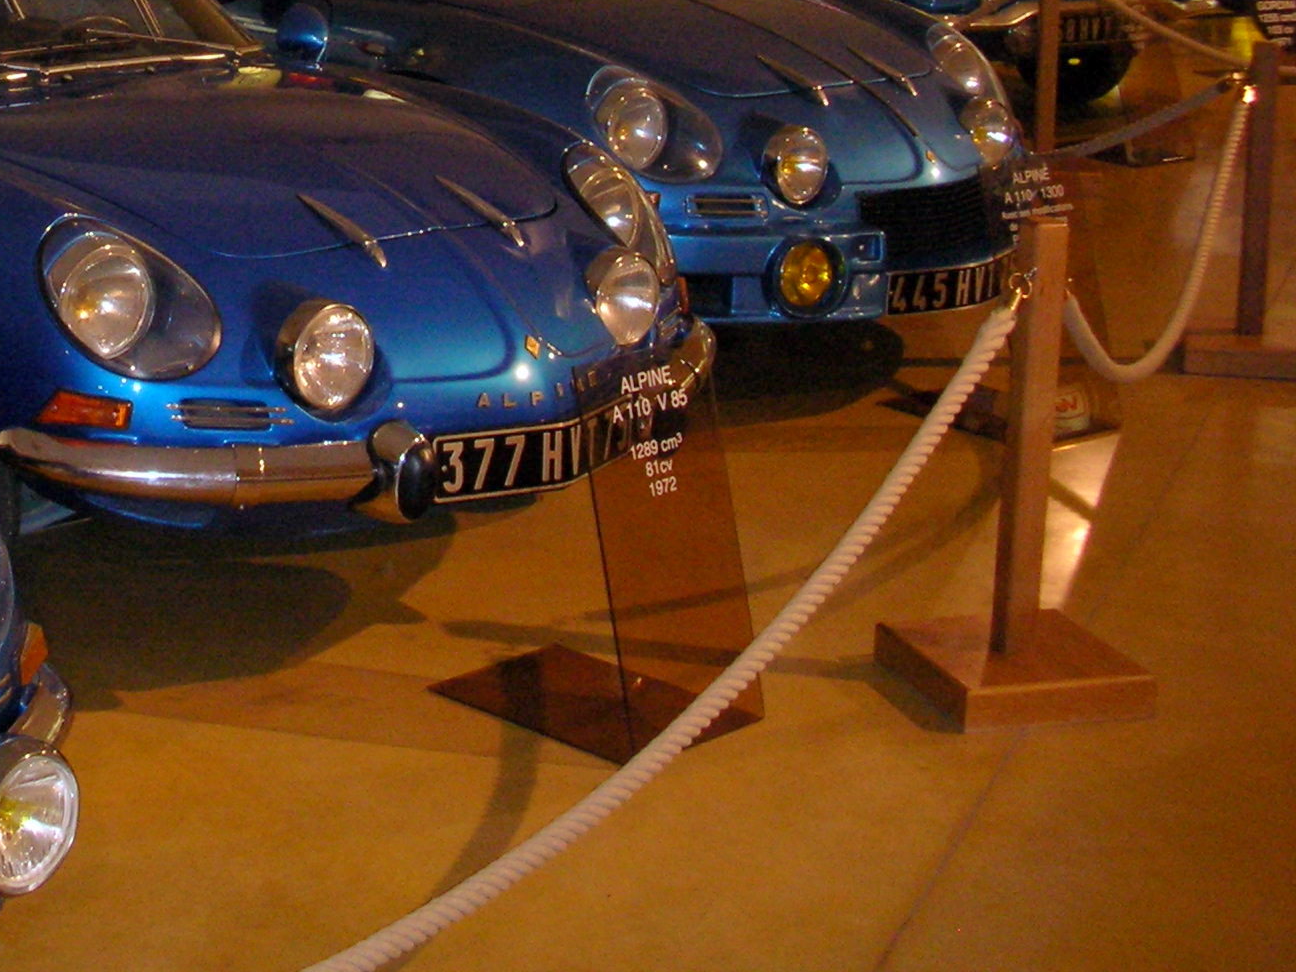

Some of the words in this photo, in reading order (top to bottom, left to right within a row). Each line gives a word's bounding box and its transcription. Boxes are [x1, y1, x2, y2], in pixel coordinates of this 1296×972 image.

[621, 365, 672, 395] ALPINE
[612, 405, 624, 424] A
[626, 397, 653, 420] 110
[656, 392, 667, 411] V
[670, 387, 689, 409] 85
[442, 434, 526, 494] 377
[630, 439, 659, 460] 1289
[649, 478, 678, 498] 1972
